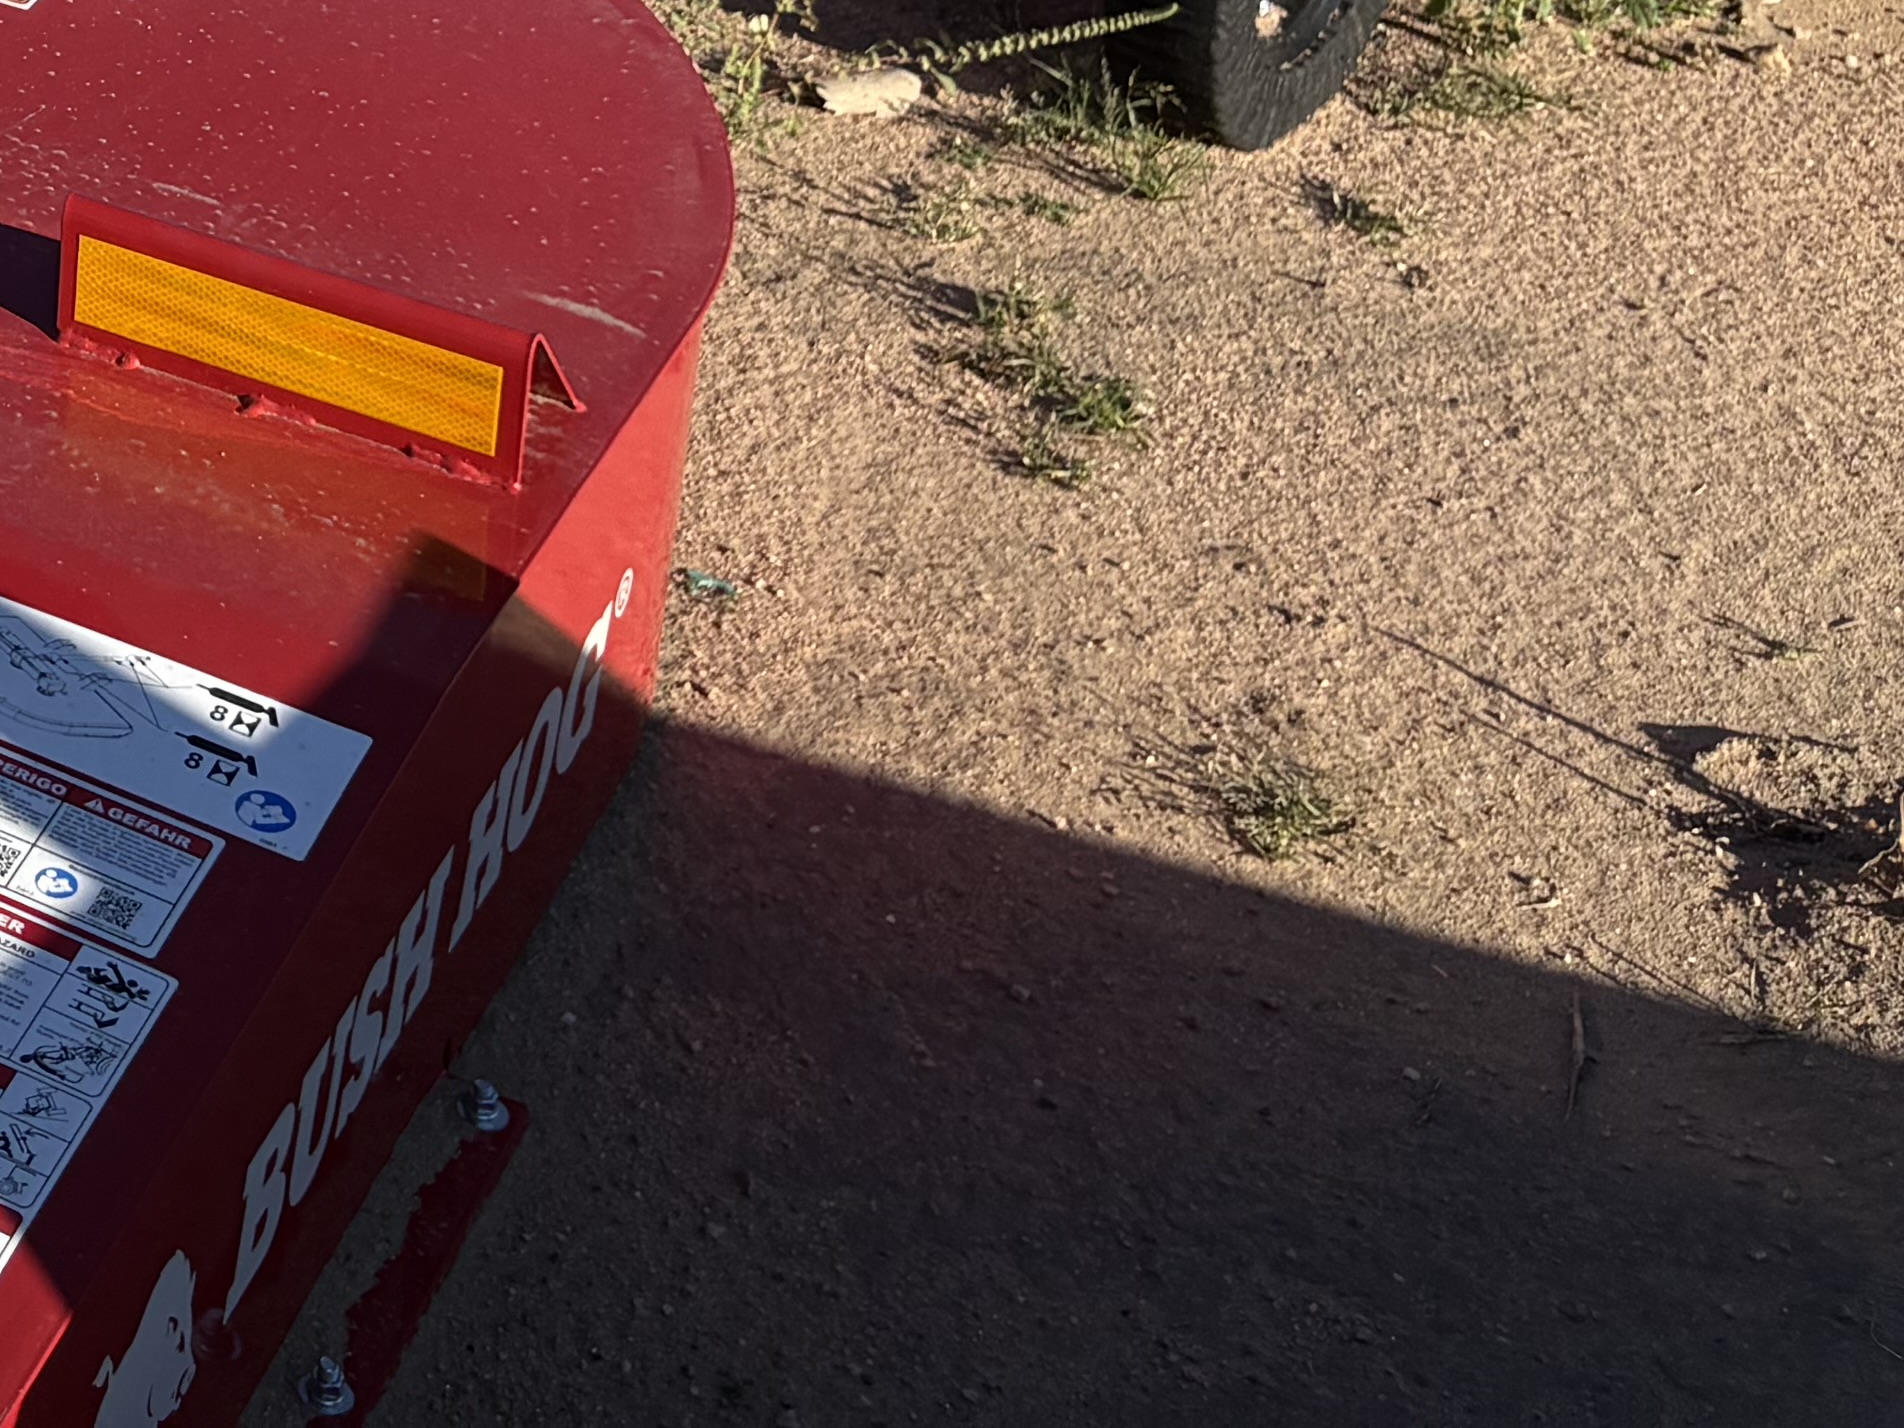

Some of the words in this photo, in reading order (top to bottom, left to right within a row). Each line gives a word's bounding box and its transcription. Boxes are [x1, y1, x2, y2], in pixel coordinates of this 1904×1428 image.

[208, 704, 229, 723] 8
[182, 750, 205, 771] 8
[106, 806, 192, 849] GEFAHR
[223, 844, 455, 1325] BUSH
[448, 600, 612, 953] HOG
